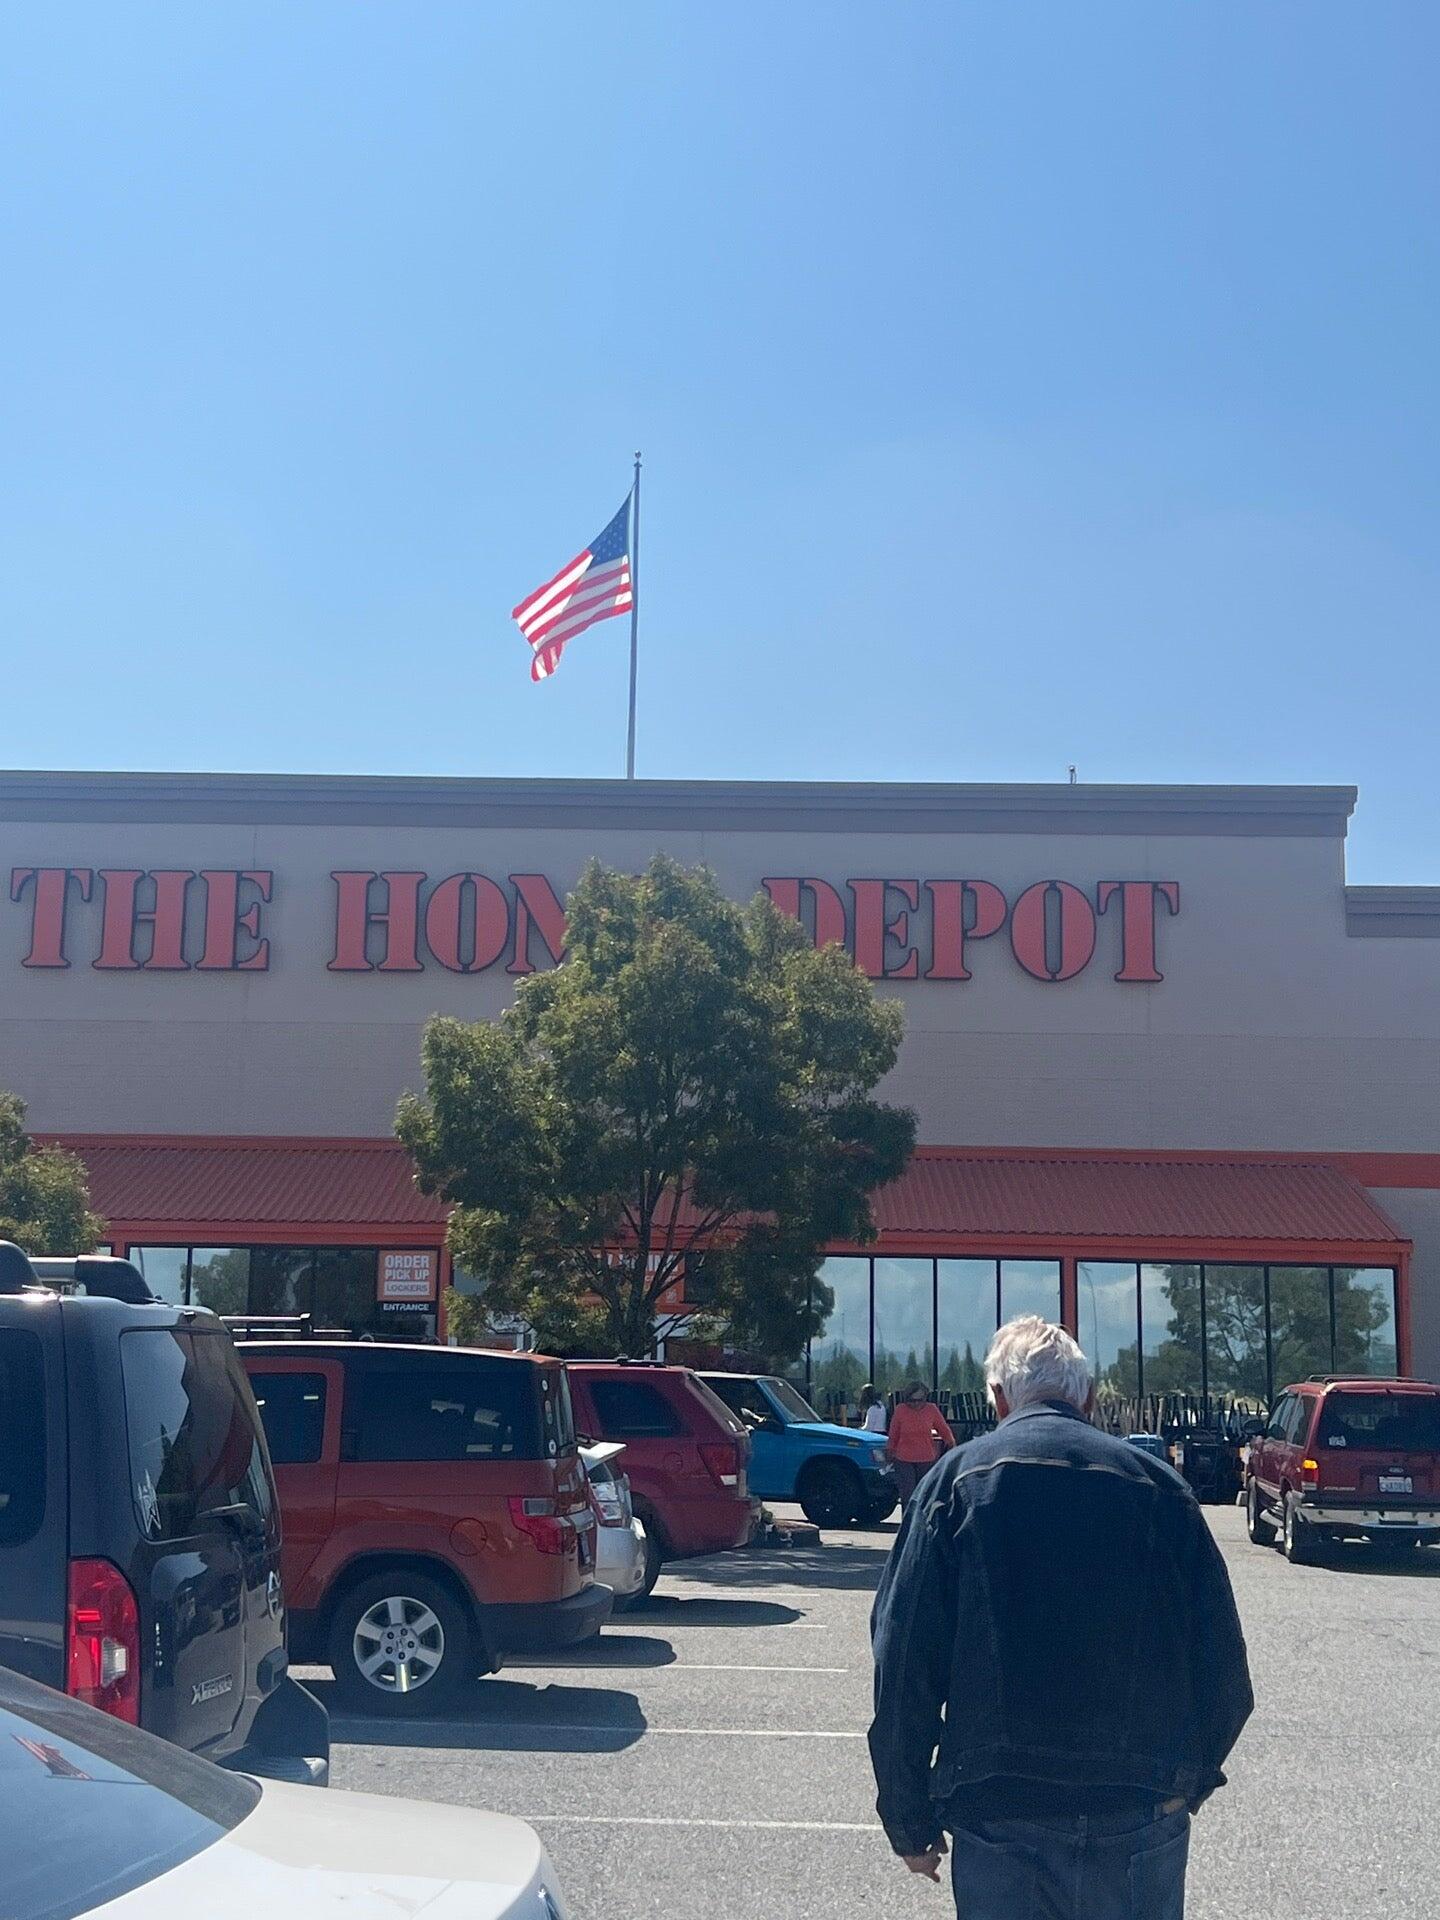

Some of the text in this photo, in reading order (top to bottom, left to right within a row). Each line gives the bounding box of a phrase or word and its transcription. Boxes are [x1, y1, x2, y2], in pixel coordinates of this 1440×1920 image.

[10, 867, 273, 972] THE
[327, 870, 569, 974] HO
[384, 1255, 430, 1268] ORDER
[384, 1269, 430, 1280] PICK UP
[383, 1303, 430, 1311] ENTRANCE
